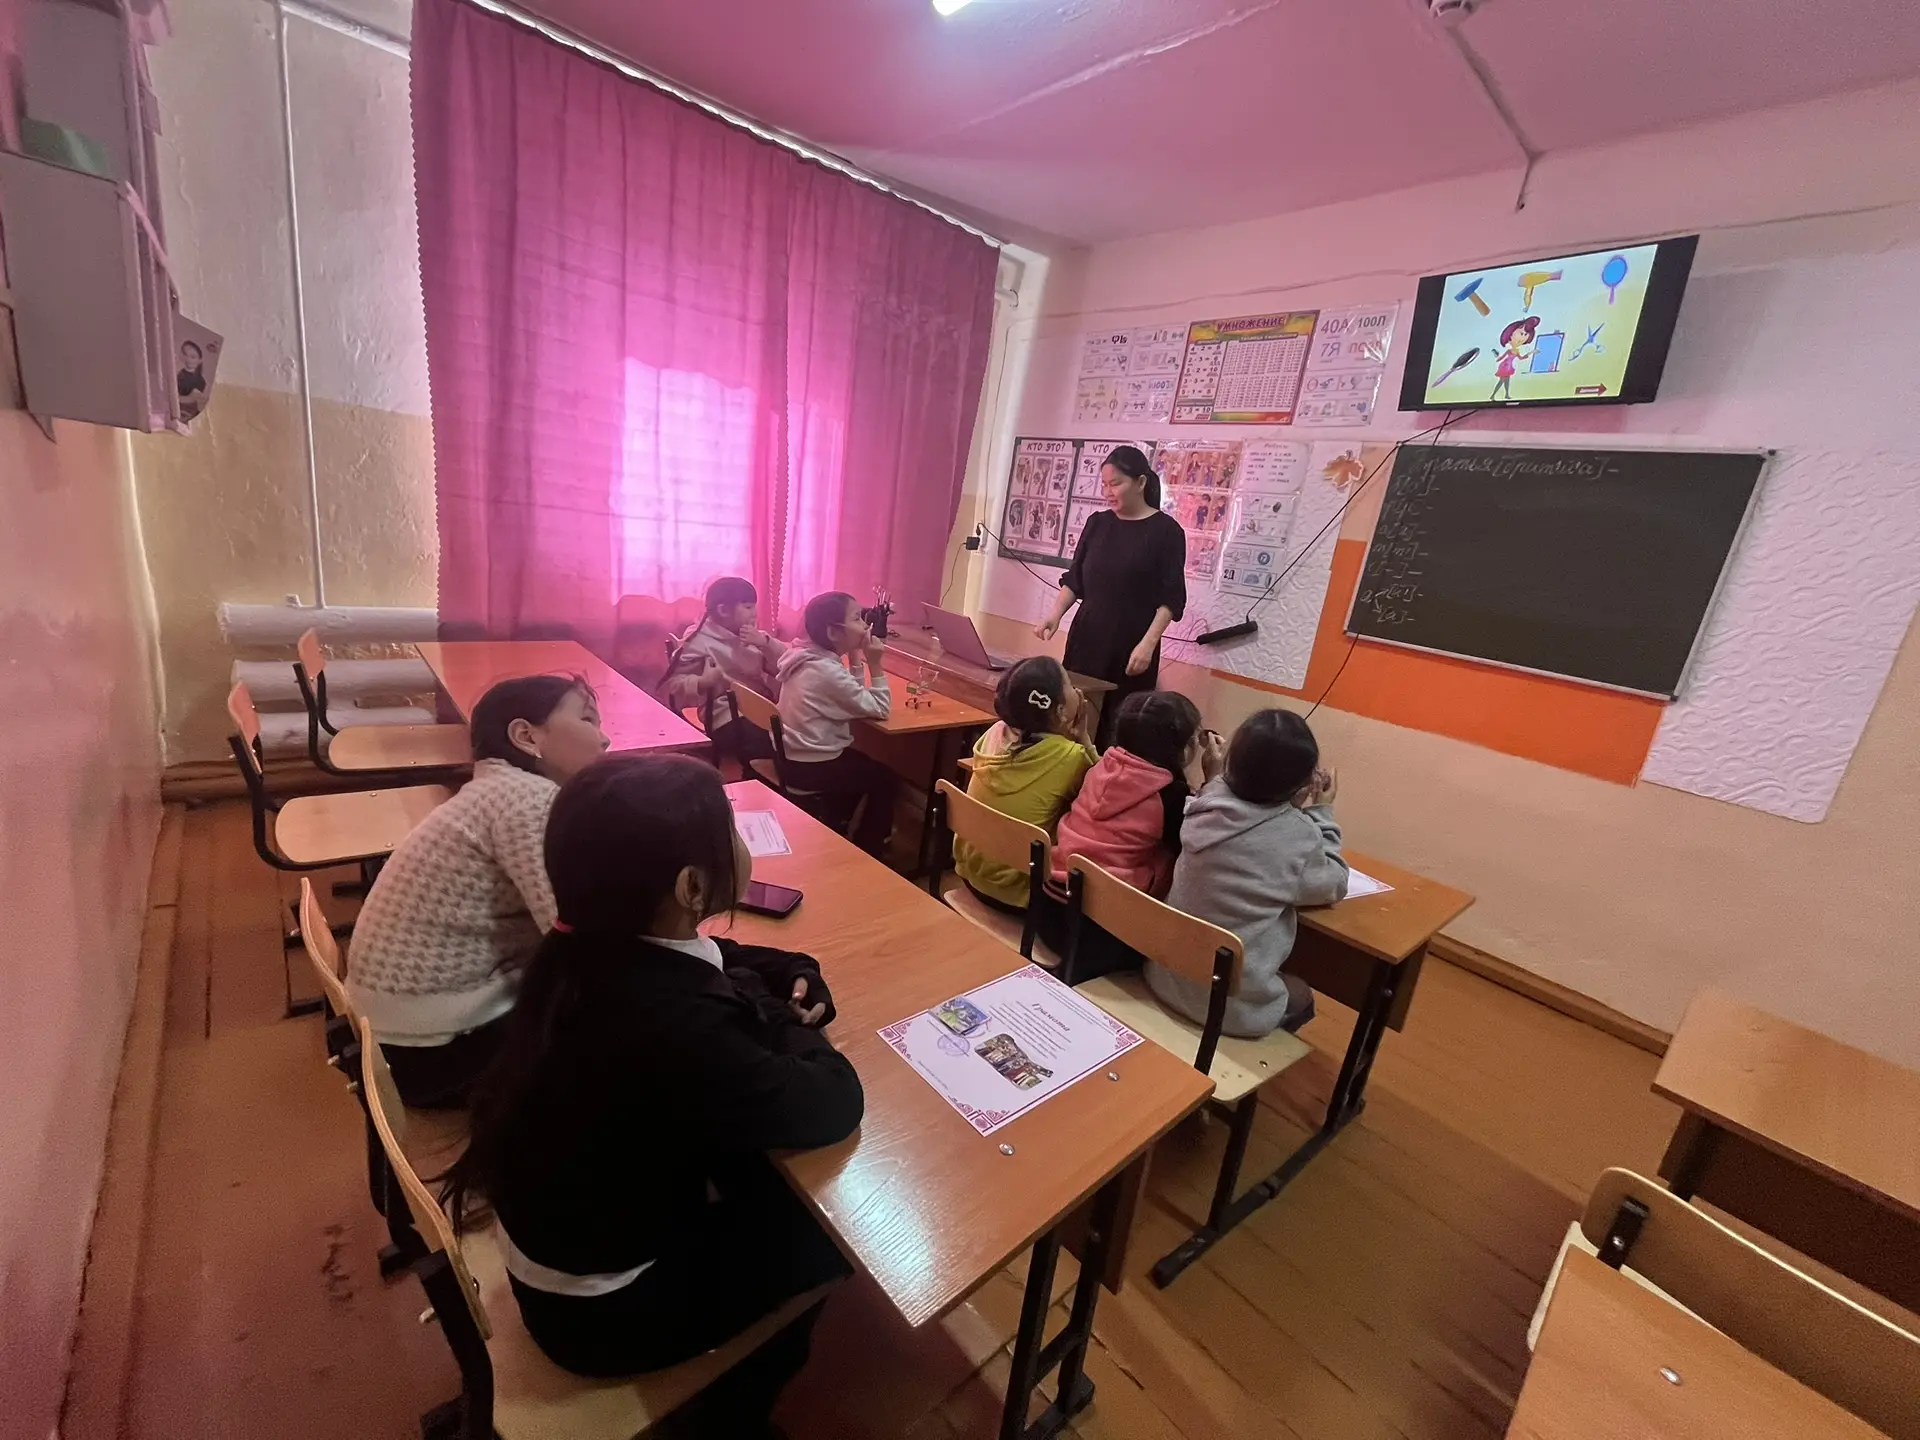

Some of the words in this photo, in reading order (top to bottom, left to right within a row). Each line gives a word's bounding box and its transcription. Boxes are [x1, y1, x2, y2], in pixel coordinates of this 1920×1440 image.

[1217, 317, 1284, 332] УМНОЖЕНИЕ
[1026, 442, 1043, 452] КТО
[1045, 441, 1066, 453] ЭТО?
[1092, 444, 1110, 453] ЧТО
[1031, 1002, 1071, 1032] Грамота
